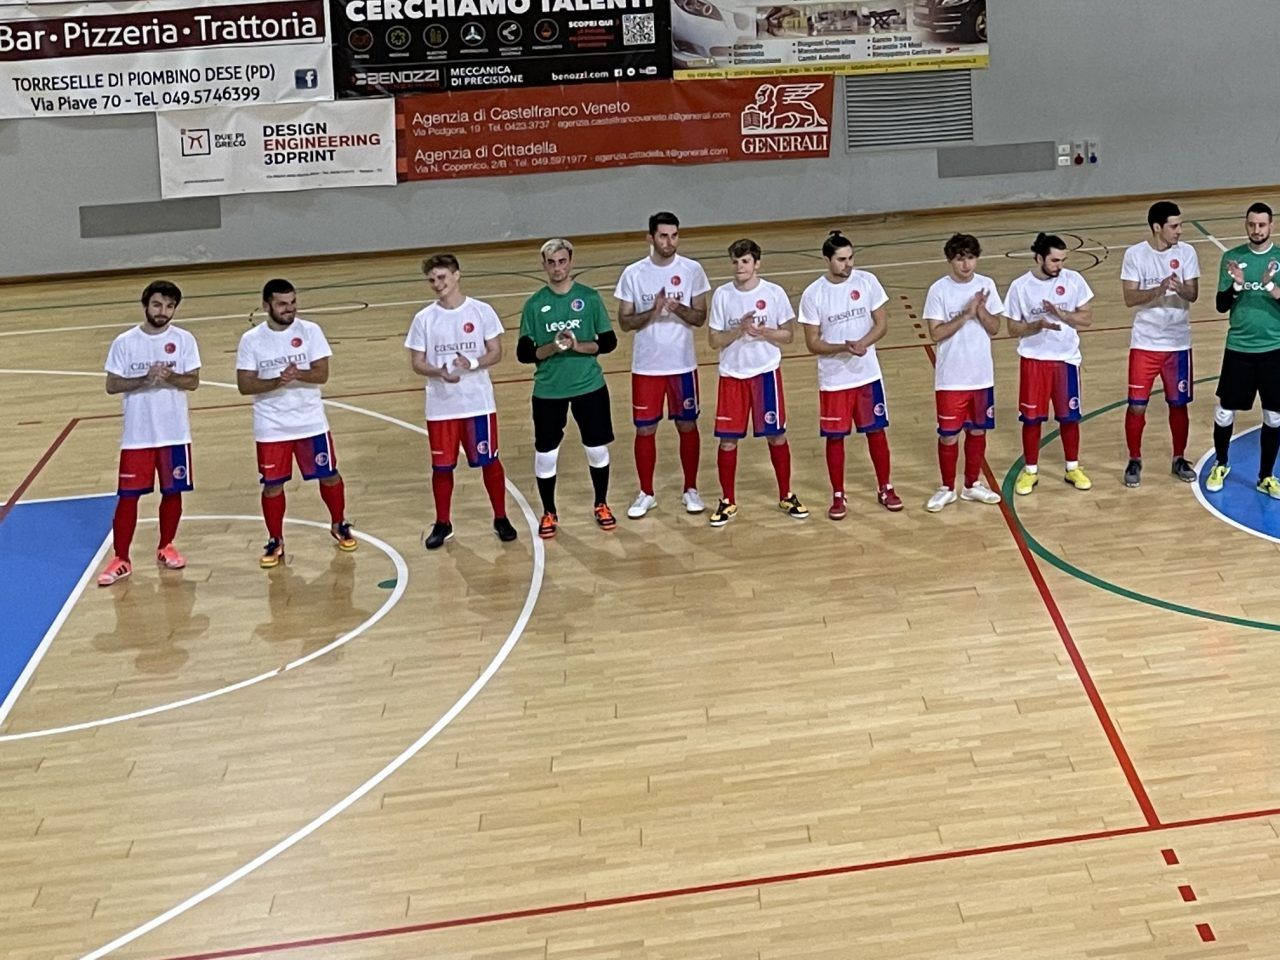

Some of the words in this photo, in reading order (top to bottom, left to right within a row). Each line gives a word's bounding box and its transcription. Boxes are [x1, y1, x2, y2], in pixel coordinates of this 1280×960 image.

[64, 19, 178, 49] Pizzeria
[194, 12, 317, 40] Trattoria
[569, 20, 596, 28] SCOPRI
[598, 19, 613, 27] QUI
[13, 74, 104, 92] TORRESELLE
[109, 74, 123, 87] DI
[129, 69, 200, 86] PIOMBINO
[206, 67, 242, 82] DESE
[246, 64, 275, 81] (PD)
[367, 70, 439, 84] BENOZZI
[451, 66, 511, 76] MECCANICA
[552, 70, 609, 81] benozzi.com
[451, 77, 462, 86] DI
[465, 74, 523, 85] PRECISIONE
[31, 97, 54, 111] Via
[59, 95, 97, 109] Piave
[102, 96, 121, 108] 70
[163, 87, 260, 105] 049.5746399
[412, 111, 469, 127] Agenzia
[473, 109, 486, 121] di
[491, 105, 578, 121] Castelfranco
[581, 101, 630, 115] Veneto
[263, 123, 327, 137] DESIGN
[215, 140, 246, 148] GRECO
[263, 134, 380, 151] ENGINEERING
[741, 134, 827, 154] GENERALI
[264, 150, 336, 165] 3DPRINT
[415, 148, 471, 164] Agenzia
[476, 146, 488, 158] di
[492, 142, 557, 157] Cittadella
[828, 306, 866, 323] casarin
[435, 342, 476, 352] casarin
[260, 353, 306, 367] casarin
